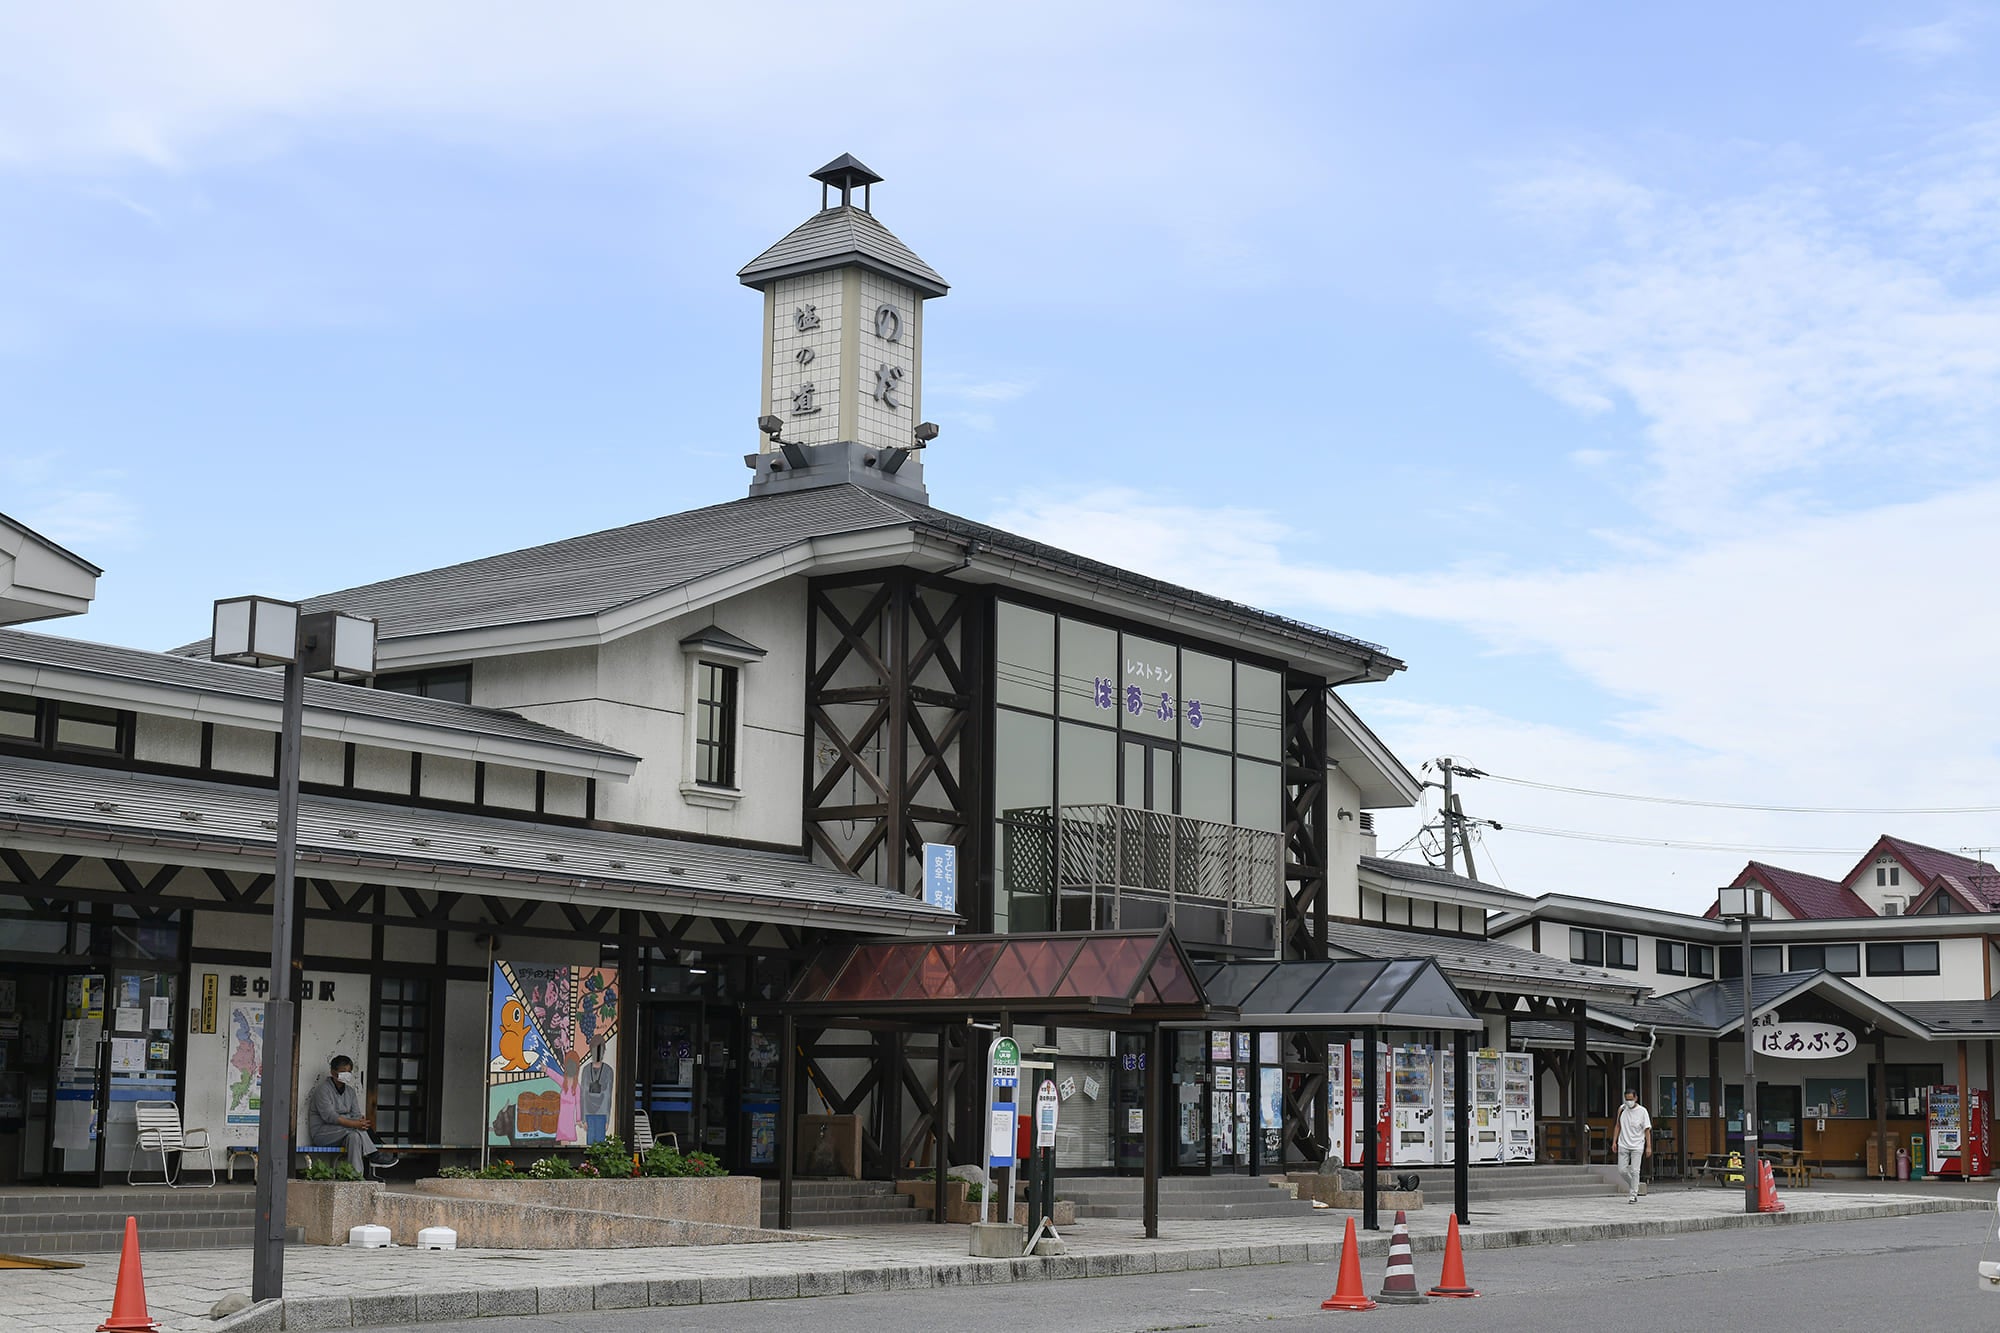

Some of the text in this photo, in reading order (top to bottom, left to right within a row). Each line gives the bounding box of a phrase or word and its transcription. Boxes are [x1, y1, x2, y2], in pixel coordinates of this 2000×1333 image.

[874, 303, 904, 410] のだ
[1127, 659, 1173, 682] レストラン
[1093, 676, 1203, 729] ぱあぷる
[229, 974, 336, 1002] 陸中田駅
[1762, 1031, 1849, 1052] ぱあぷる
